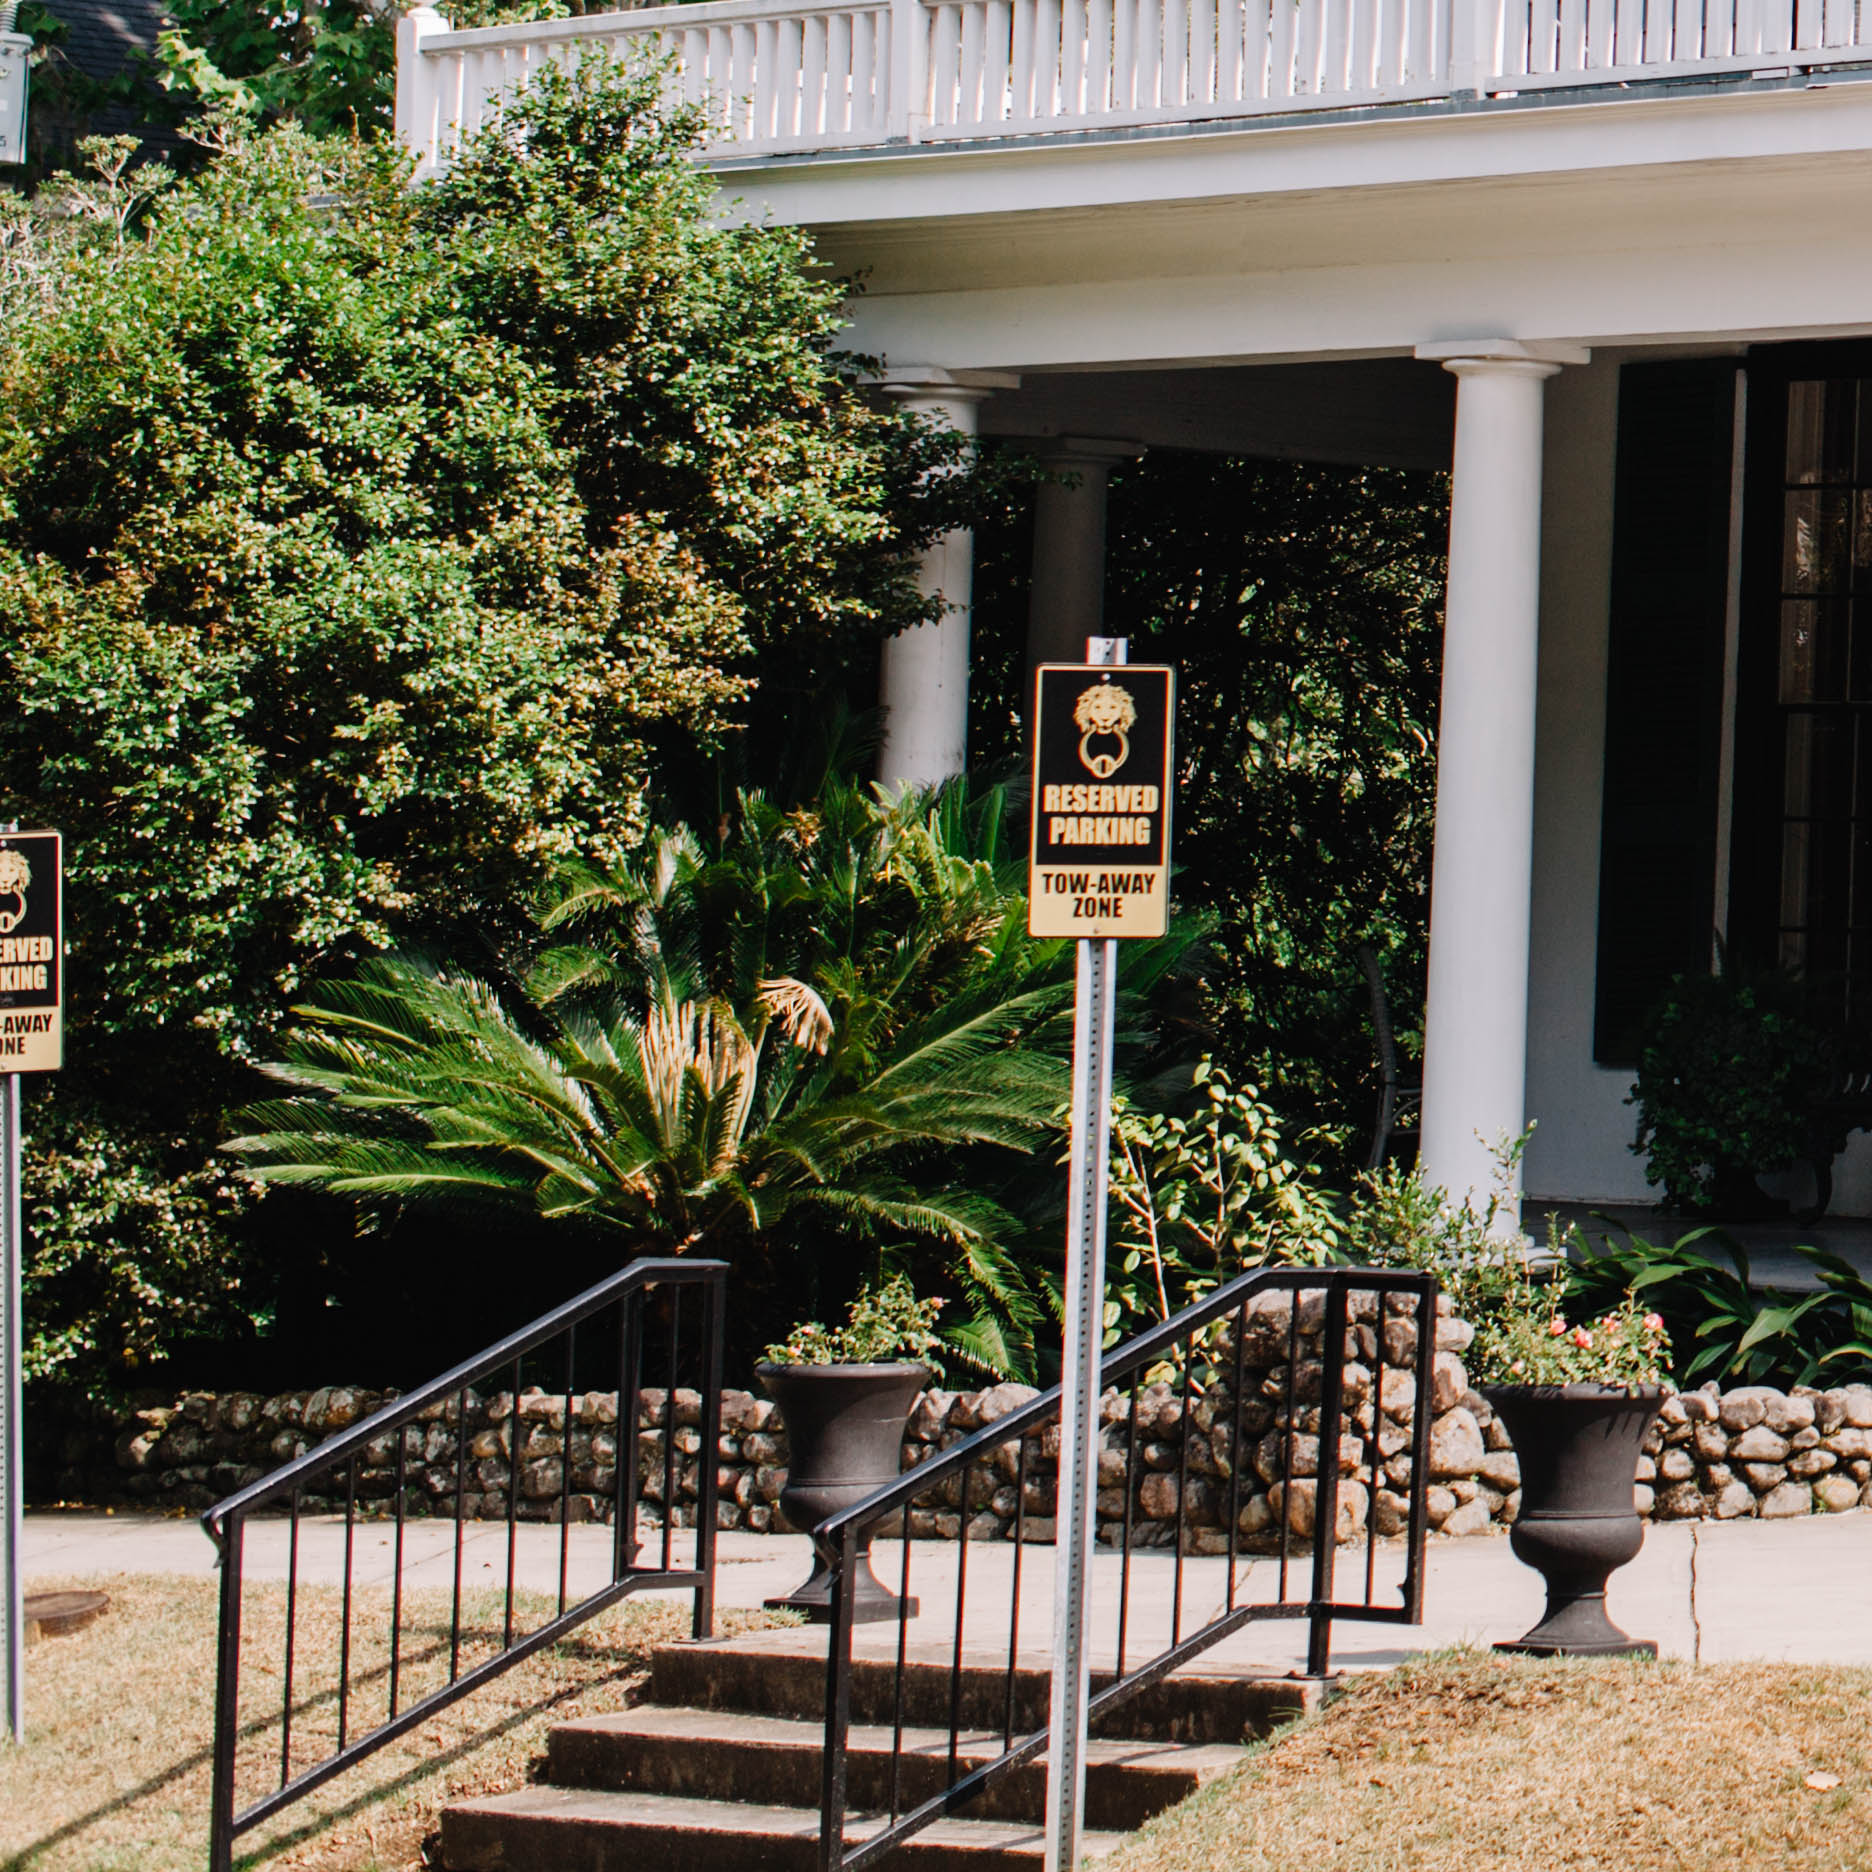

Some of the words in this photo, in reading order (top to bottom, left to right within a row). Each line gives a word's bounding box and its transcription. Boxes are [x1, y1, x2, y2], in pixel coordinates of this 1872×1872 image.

[1044, 784, 1159, 813] RESERVED
[1050, 816, 1151, 845] PARKING
[1042, 873, 1156, 895] TOW-AWAY
[1073, 897, 1123, 918] ZONE
[0, 936, 53, 963] RVED
